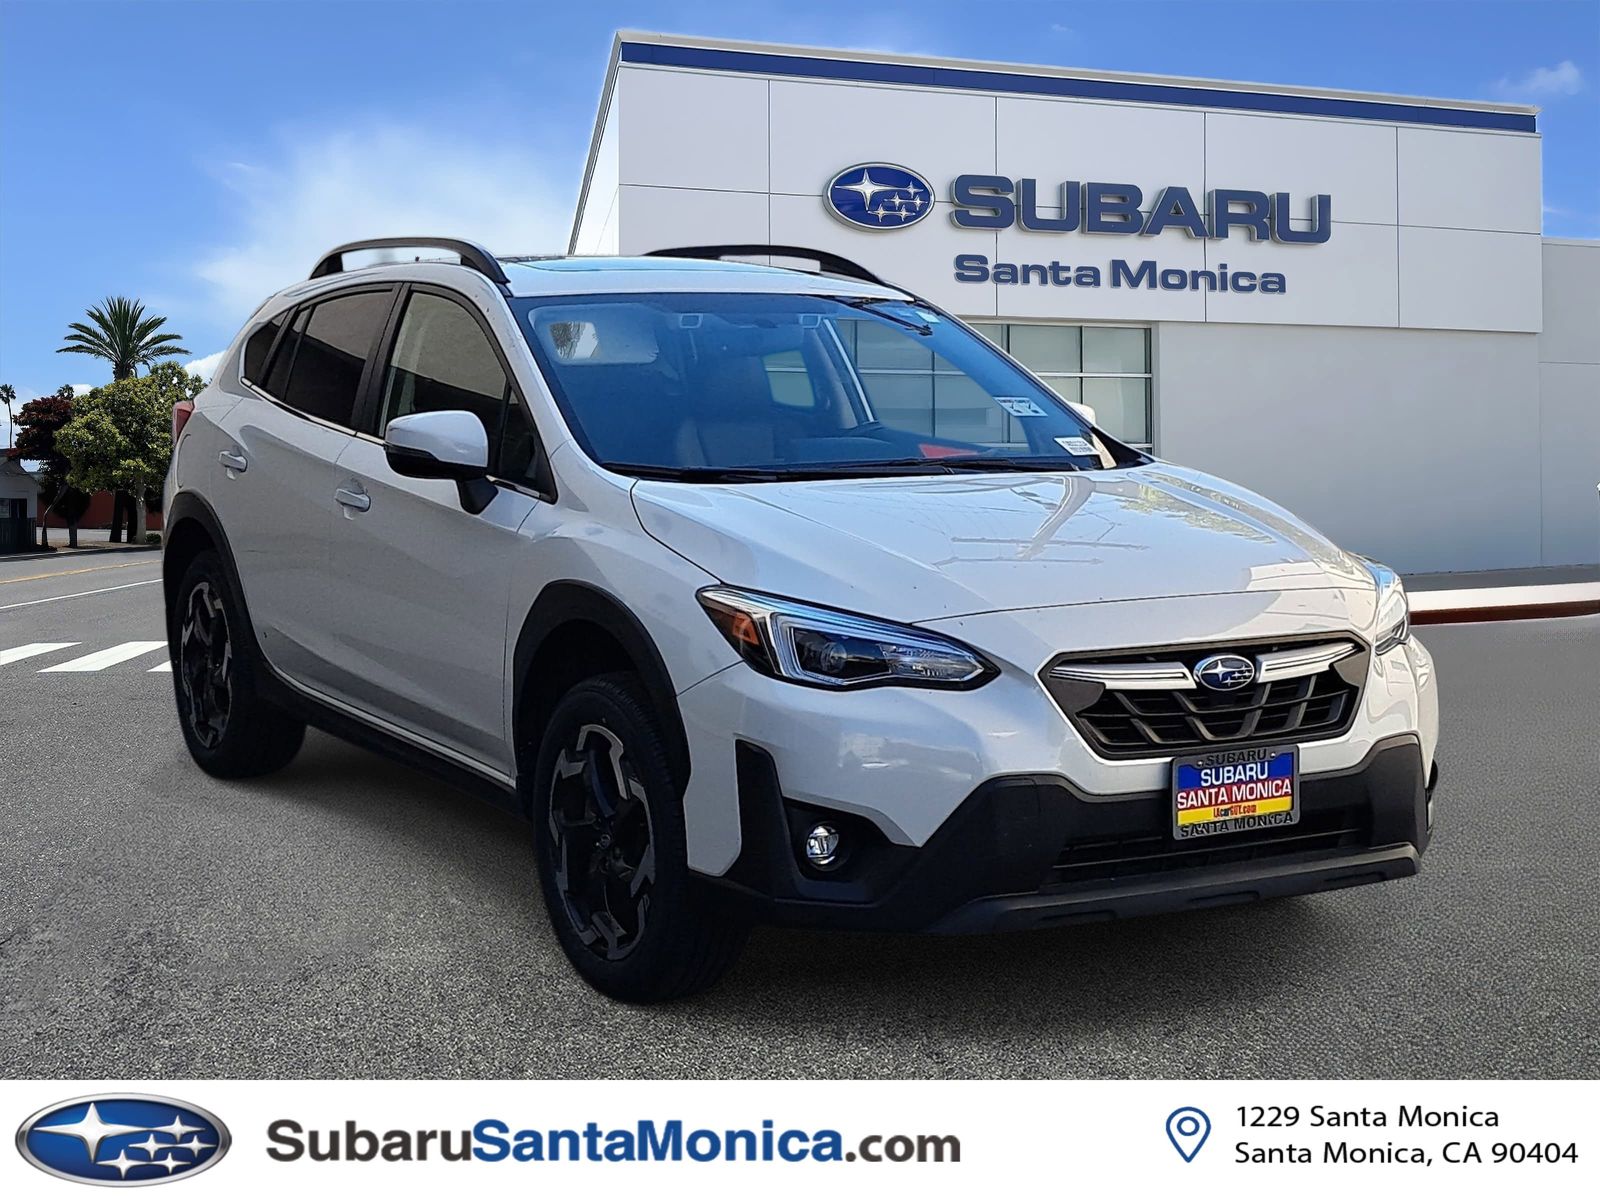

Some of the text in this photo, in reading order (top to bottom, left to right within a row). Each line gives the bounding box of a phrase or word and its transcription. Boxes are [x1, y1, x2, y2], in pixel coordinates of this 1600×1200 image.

[951, 174, 1332, 244] SUBARU
[953, 253, 1287, 294] Santa Monica
[1204, 749, 1267, 766] SUBARU
[1201, 762, 1268, 787] SUBARU
[1177, 779, 1292, 809] SANTA MONICA
[1180, 812, 1293, 838] SANTA MONICA
